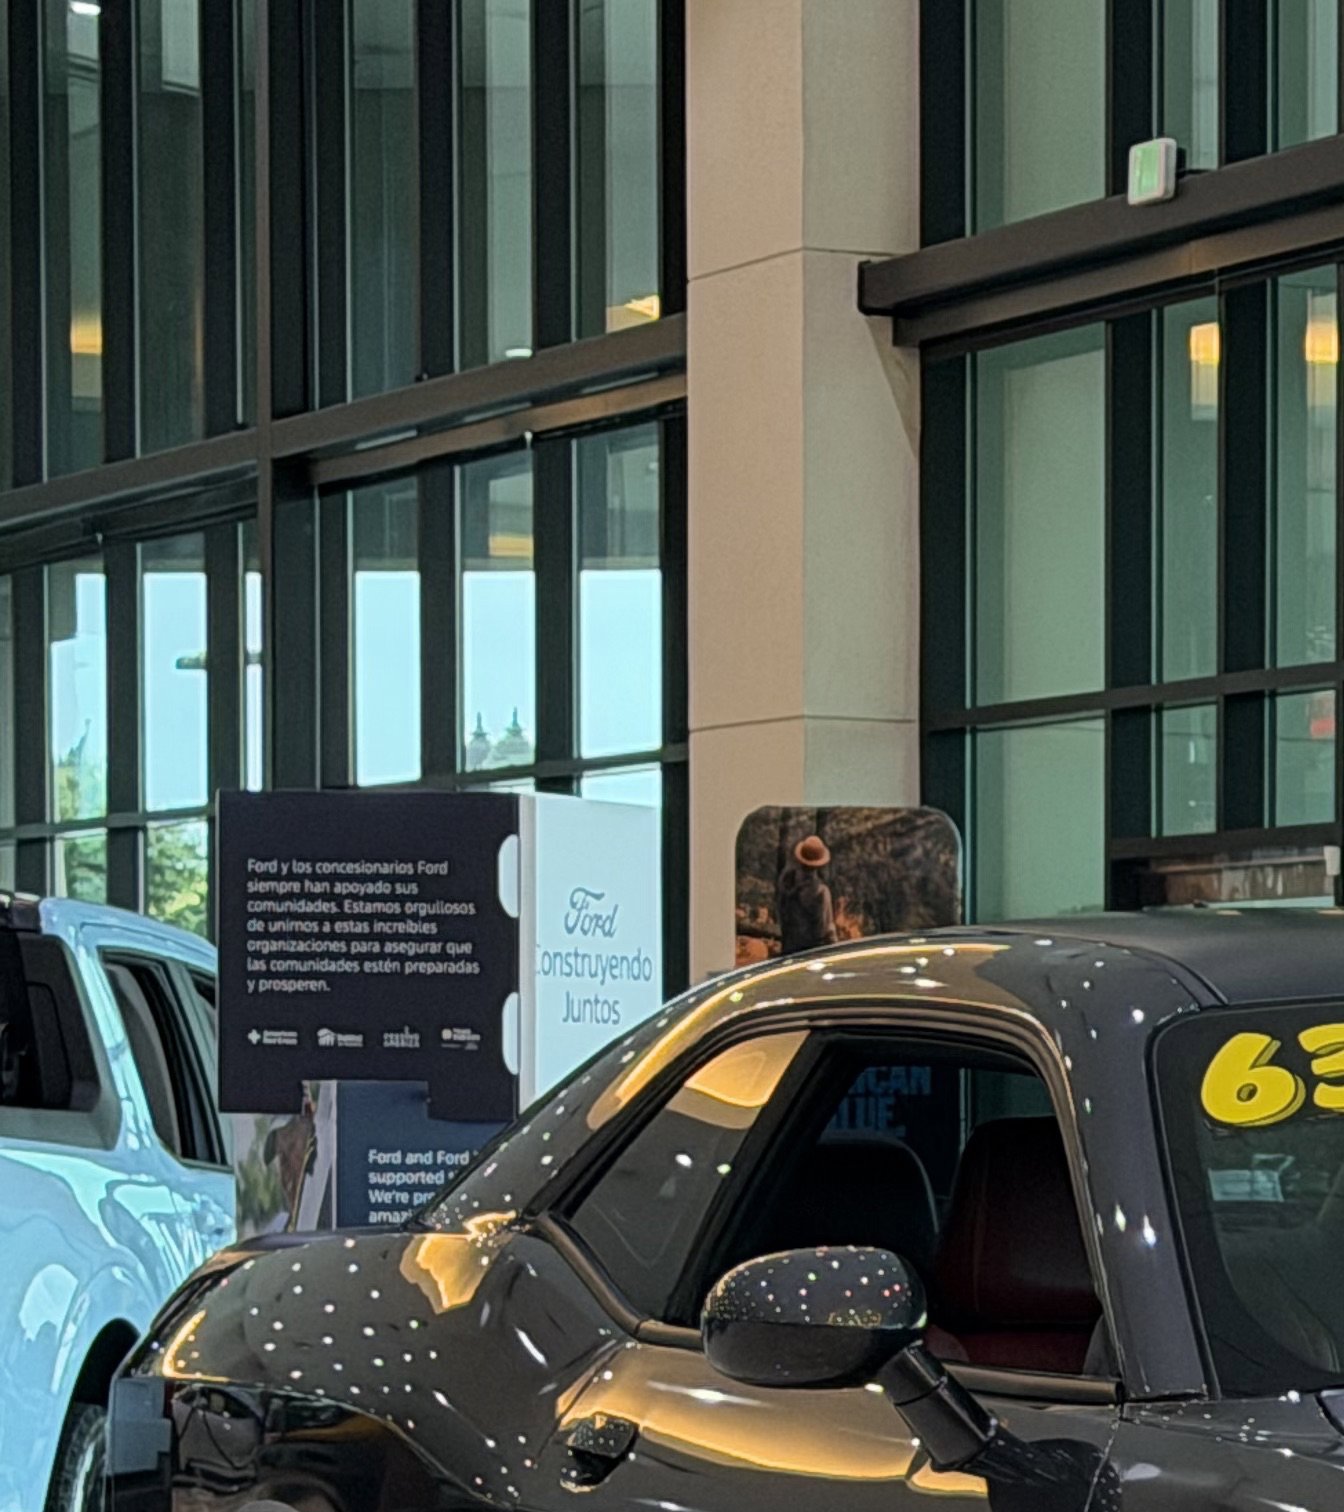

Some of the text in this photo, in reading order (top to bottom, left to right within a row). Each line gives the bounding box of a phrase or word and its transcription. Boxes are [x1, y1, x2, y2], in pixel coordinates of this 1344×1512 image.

[247, 858, 449, 876] Ford y los concesionarios Ford
[247, 879, 419, 896] siempre han apoyado sus
[247, 899, 341, 914] comunidades.
[343, 900, 401, 914] Estamos
[564, 886, 619, 938] Ford
[247, 918, 266, 932] de
[322, 921, 331, 933] a
[334, 920, 370, 934] estas
[247, 939, 473, 958] organizaciones para asegurar que
[247, 957, 267, 972] las
[269, 957, 361, 973] comunidades
[404, 960, 480, 975] preparadas
[536, 944, 653, 986] onstruyendo
[247, 979, 332, 994] y prosperen.
[562, 990, 621, 1025] Juntos
[368, 1149, 402, 1164] Ford
[405, 1150, 433, 1164] and
[436, 1150, 470, 1165] Ford
[368, 1169, 445, 1186] supported
[368, 1189, 410, 1204] We're
